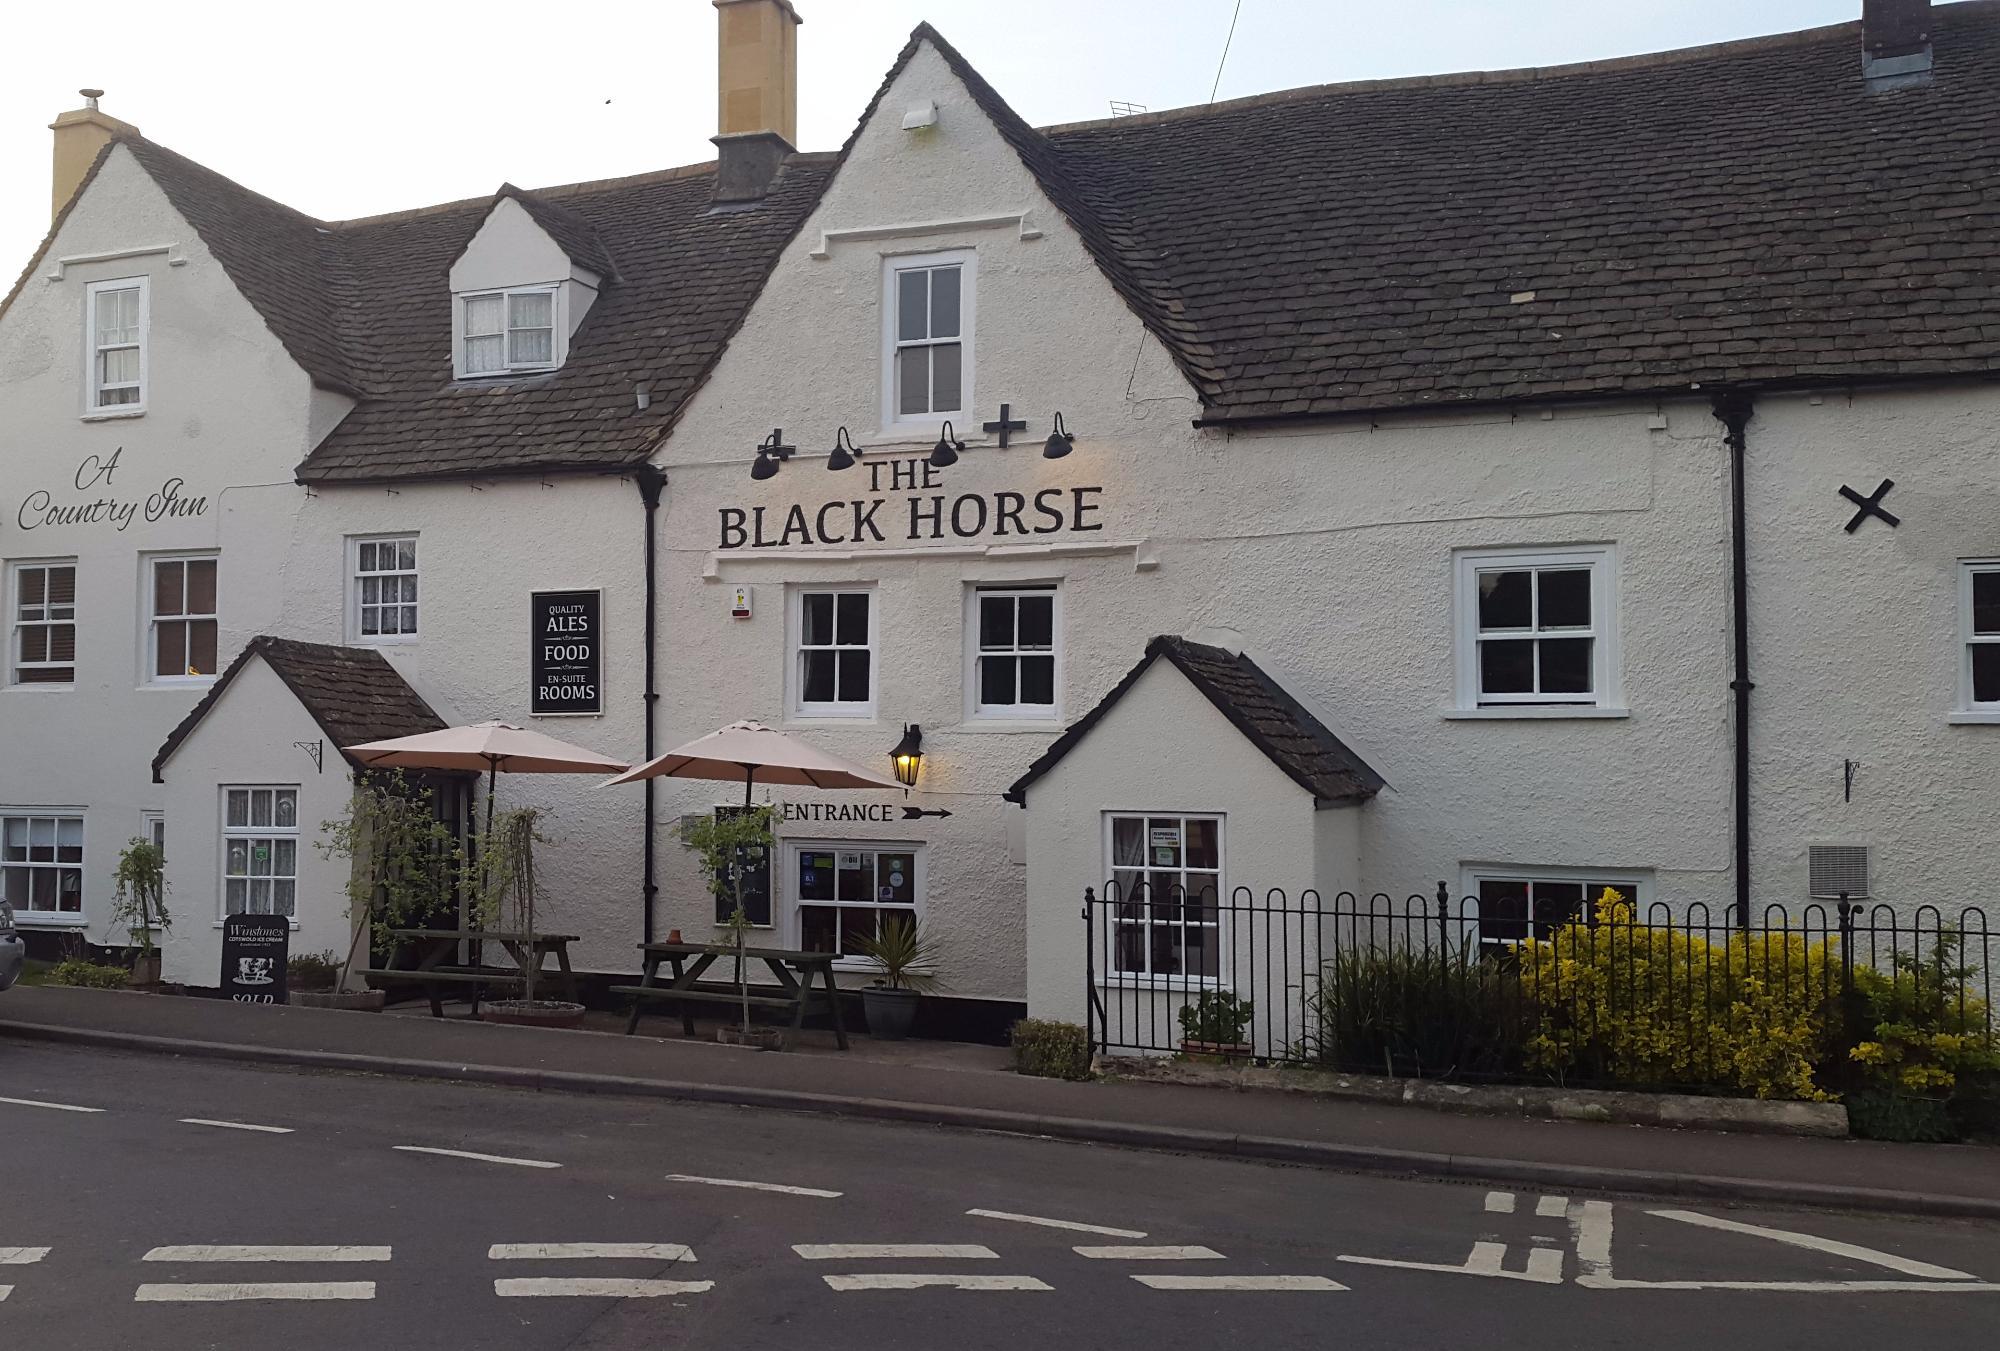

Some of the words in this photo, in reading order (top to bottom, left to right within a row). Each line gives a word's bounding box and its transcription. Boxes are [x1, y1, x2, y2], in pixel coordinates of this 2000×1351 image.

[75, 446, 123, 490] A
[863, 458, 943, 492] THE
[18, 490, 138, 531] Country
[145, 478, 209, 522] Inn
[718, 499, 886, 549] BLACK
[906, 486, 1103, 540] HORSE
[549, 604, 585, 615] QUALITY
[546, 616, 588, 632] ALES
[544, 645, 590, 661] FOOD
[547, 674, 586, 684] EN-SUITE
[539, 685, 595, 700] ROOMS
[783, 803, 894, 821] ENTRANCE
[228, 924, 284, 937] Winstones
